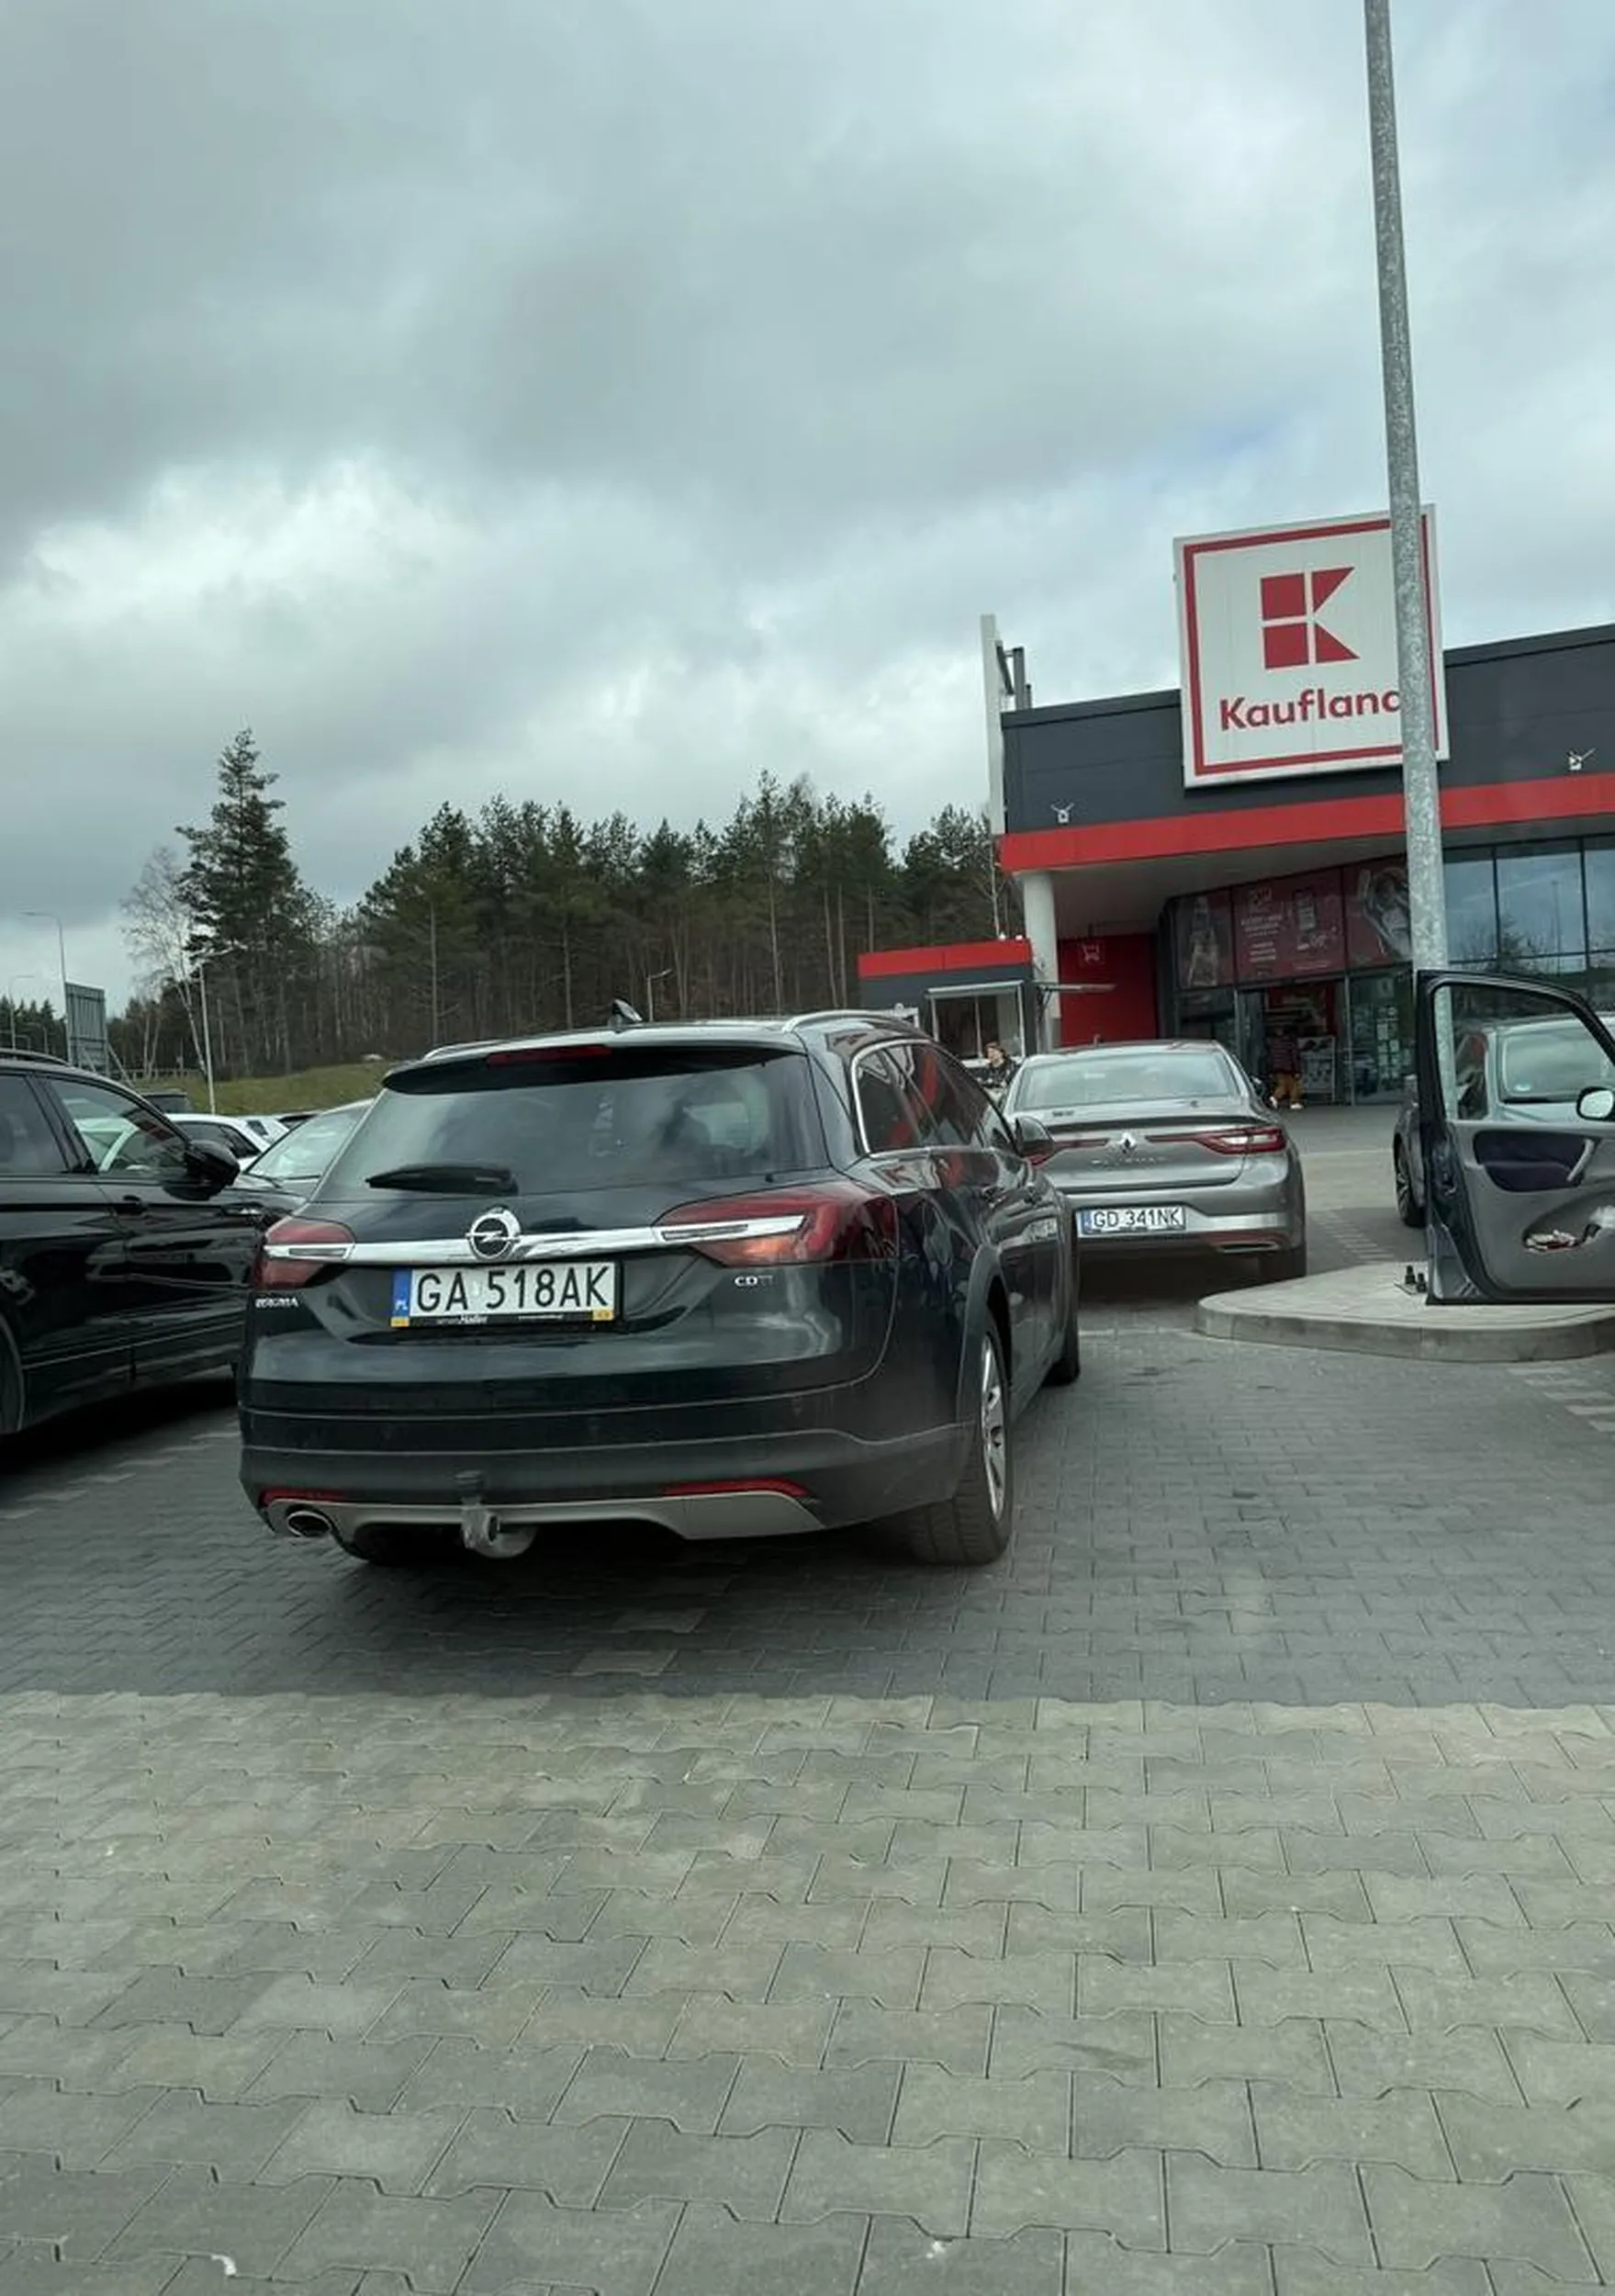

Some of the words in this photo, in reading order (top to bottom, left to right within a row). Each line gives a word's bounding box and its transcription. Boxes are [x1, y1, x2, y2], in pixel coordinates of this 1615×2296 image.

[1093, 1210, 1119, 1228] GD
[1126, 1206, 1180, 1227] 341NK
[418, 1271, 469, 1312] GA
[486, 1265, 610, 1310] 518AK
